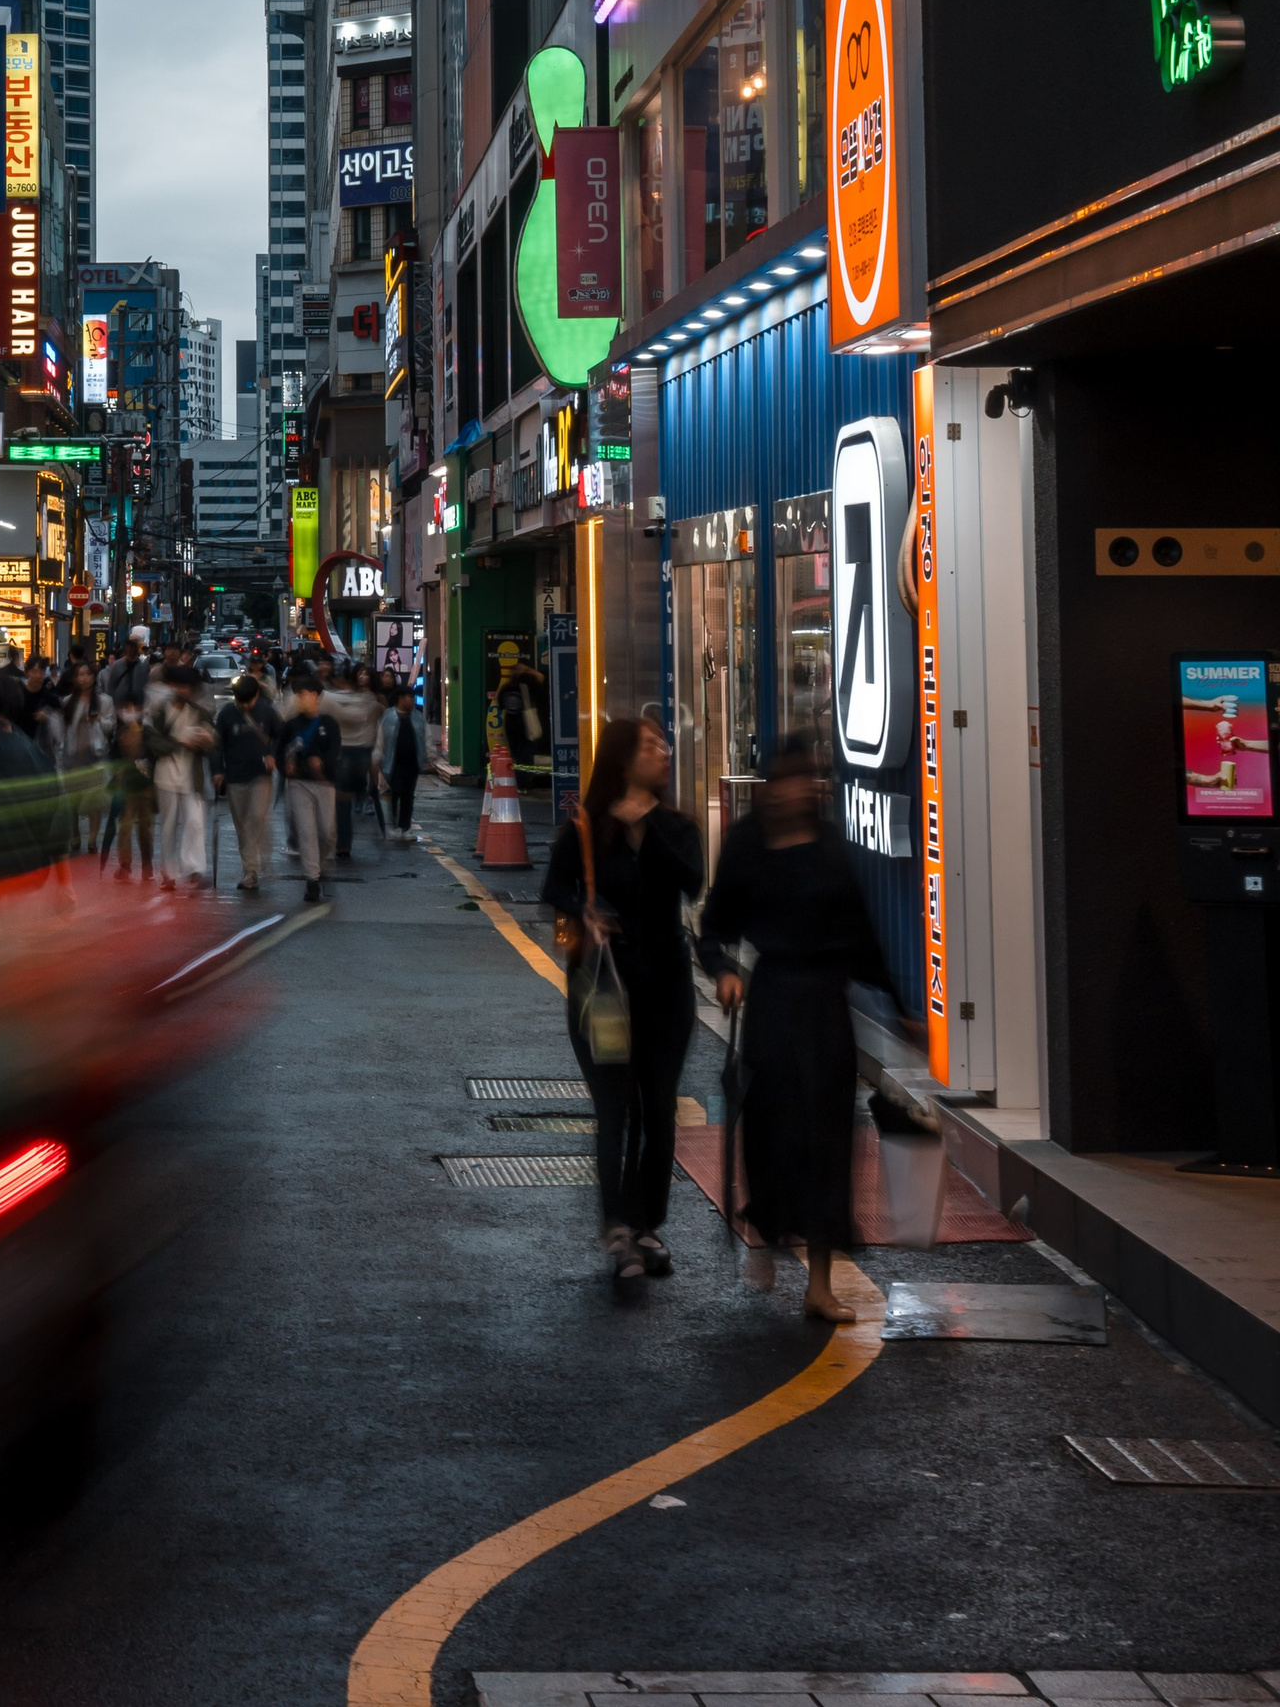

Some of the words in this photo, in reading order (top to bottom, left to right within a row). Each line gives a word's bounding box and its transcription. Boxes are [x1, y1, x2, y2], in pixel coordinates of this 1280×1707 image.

[6, 76, 34, 178] 부동산
[587, 157, 609, 244] OPEN
[11, 207, 36, 276] JUNO
[76, 268, 124, 284] OTEL
[11, 289, 36, 355] HAIR
[353, 301, 379, 343] 더
[296, 491, 317, 501] ABC
[918, 434, 933, 584] 안경
[93, 547, 103, 587] 스티커사진
[1186, 666, 1260, 680] SUMMER
